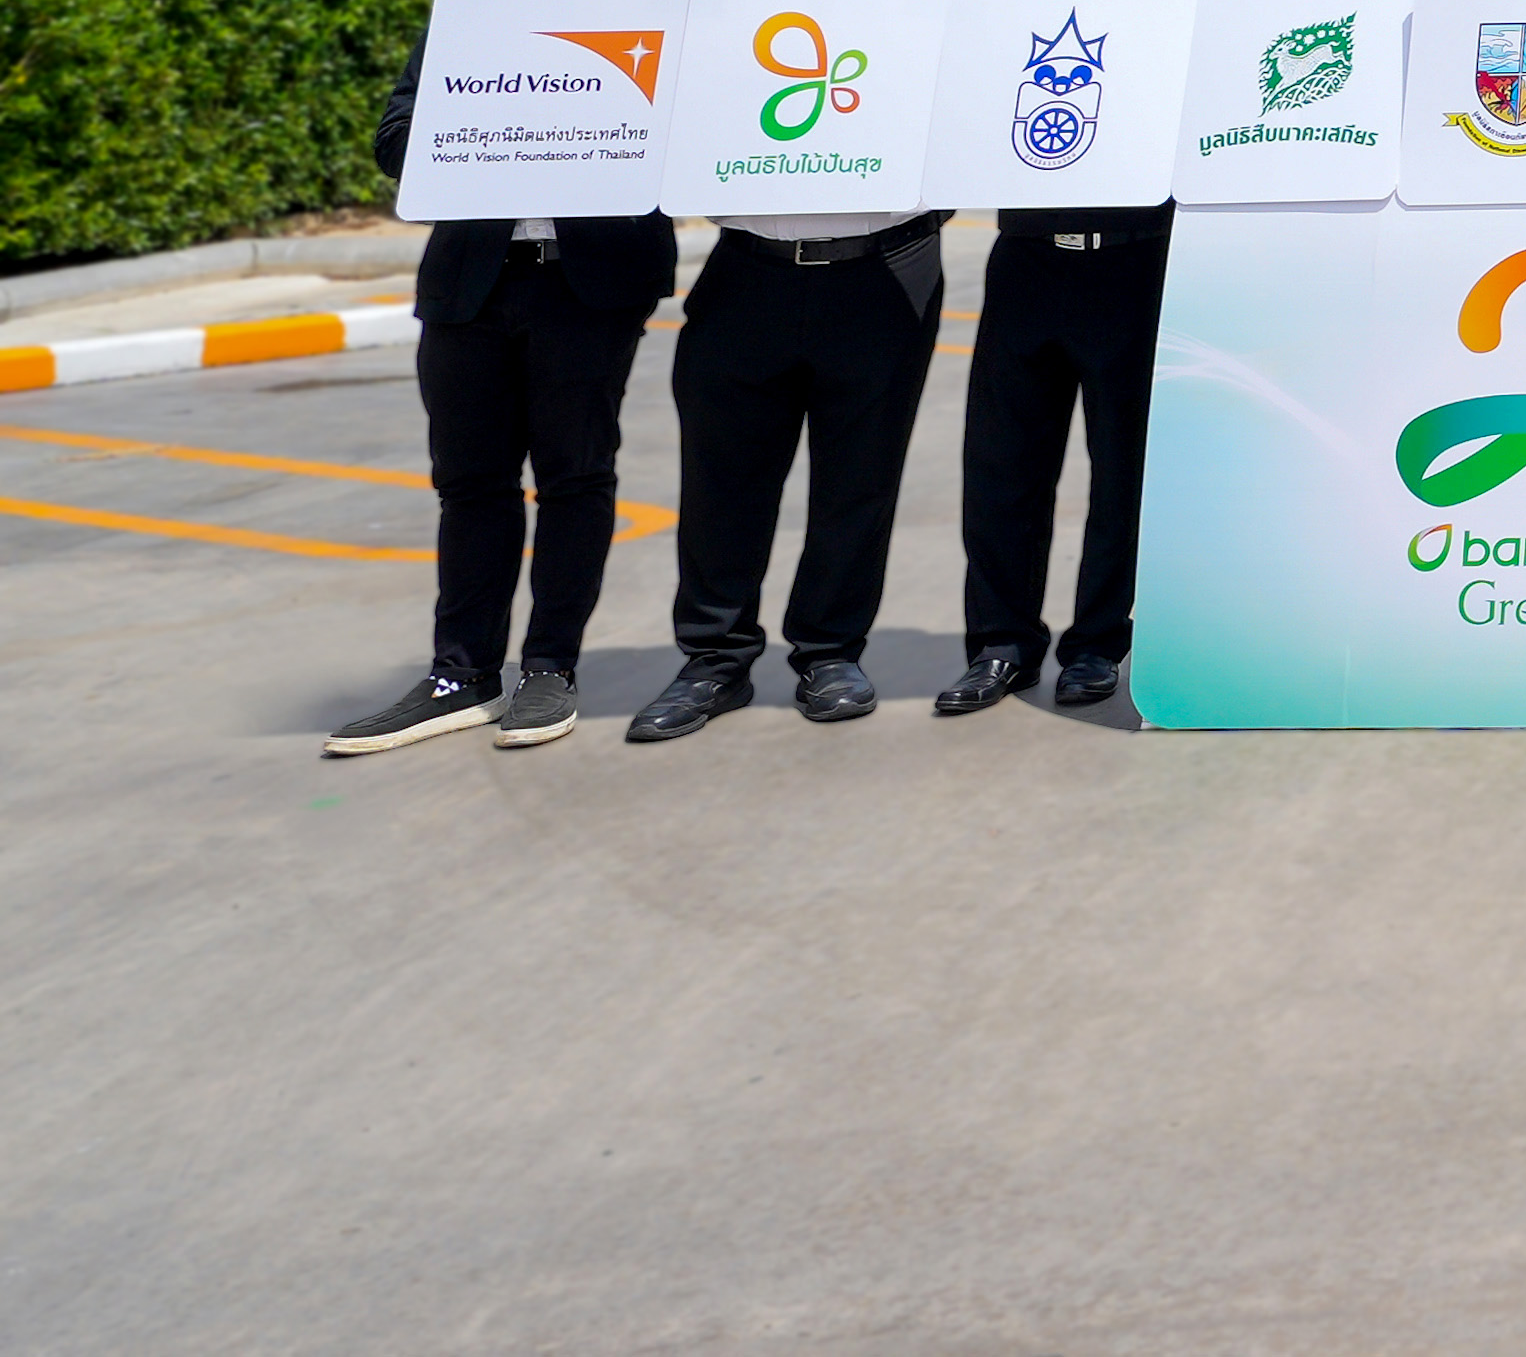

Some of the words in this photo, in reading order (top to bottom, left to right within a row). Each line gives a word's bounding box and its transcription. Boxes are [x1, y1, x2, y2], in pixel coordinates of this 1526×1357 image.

[444, 73, 522, 94] World
[527, 73, 602, 94] Vision
[433, 123, 649, 148] มูลนิธิศุภนิมิตแห่งประเทศไทย
[1199, 123, 1379, 157] มูลนิธิสืบนาคะเสถียร
[431, 152, 470, 163] World
[475, 152, 510, 163] Vision
[514, 150, 578, 162] Foundation
[581, 149, 595, 161] of
[598, 148, 646, 161] Thailand
[715, 152, 883, 183] มูลนิธิใบไม้ปันสุข
